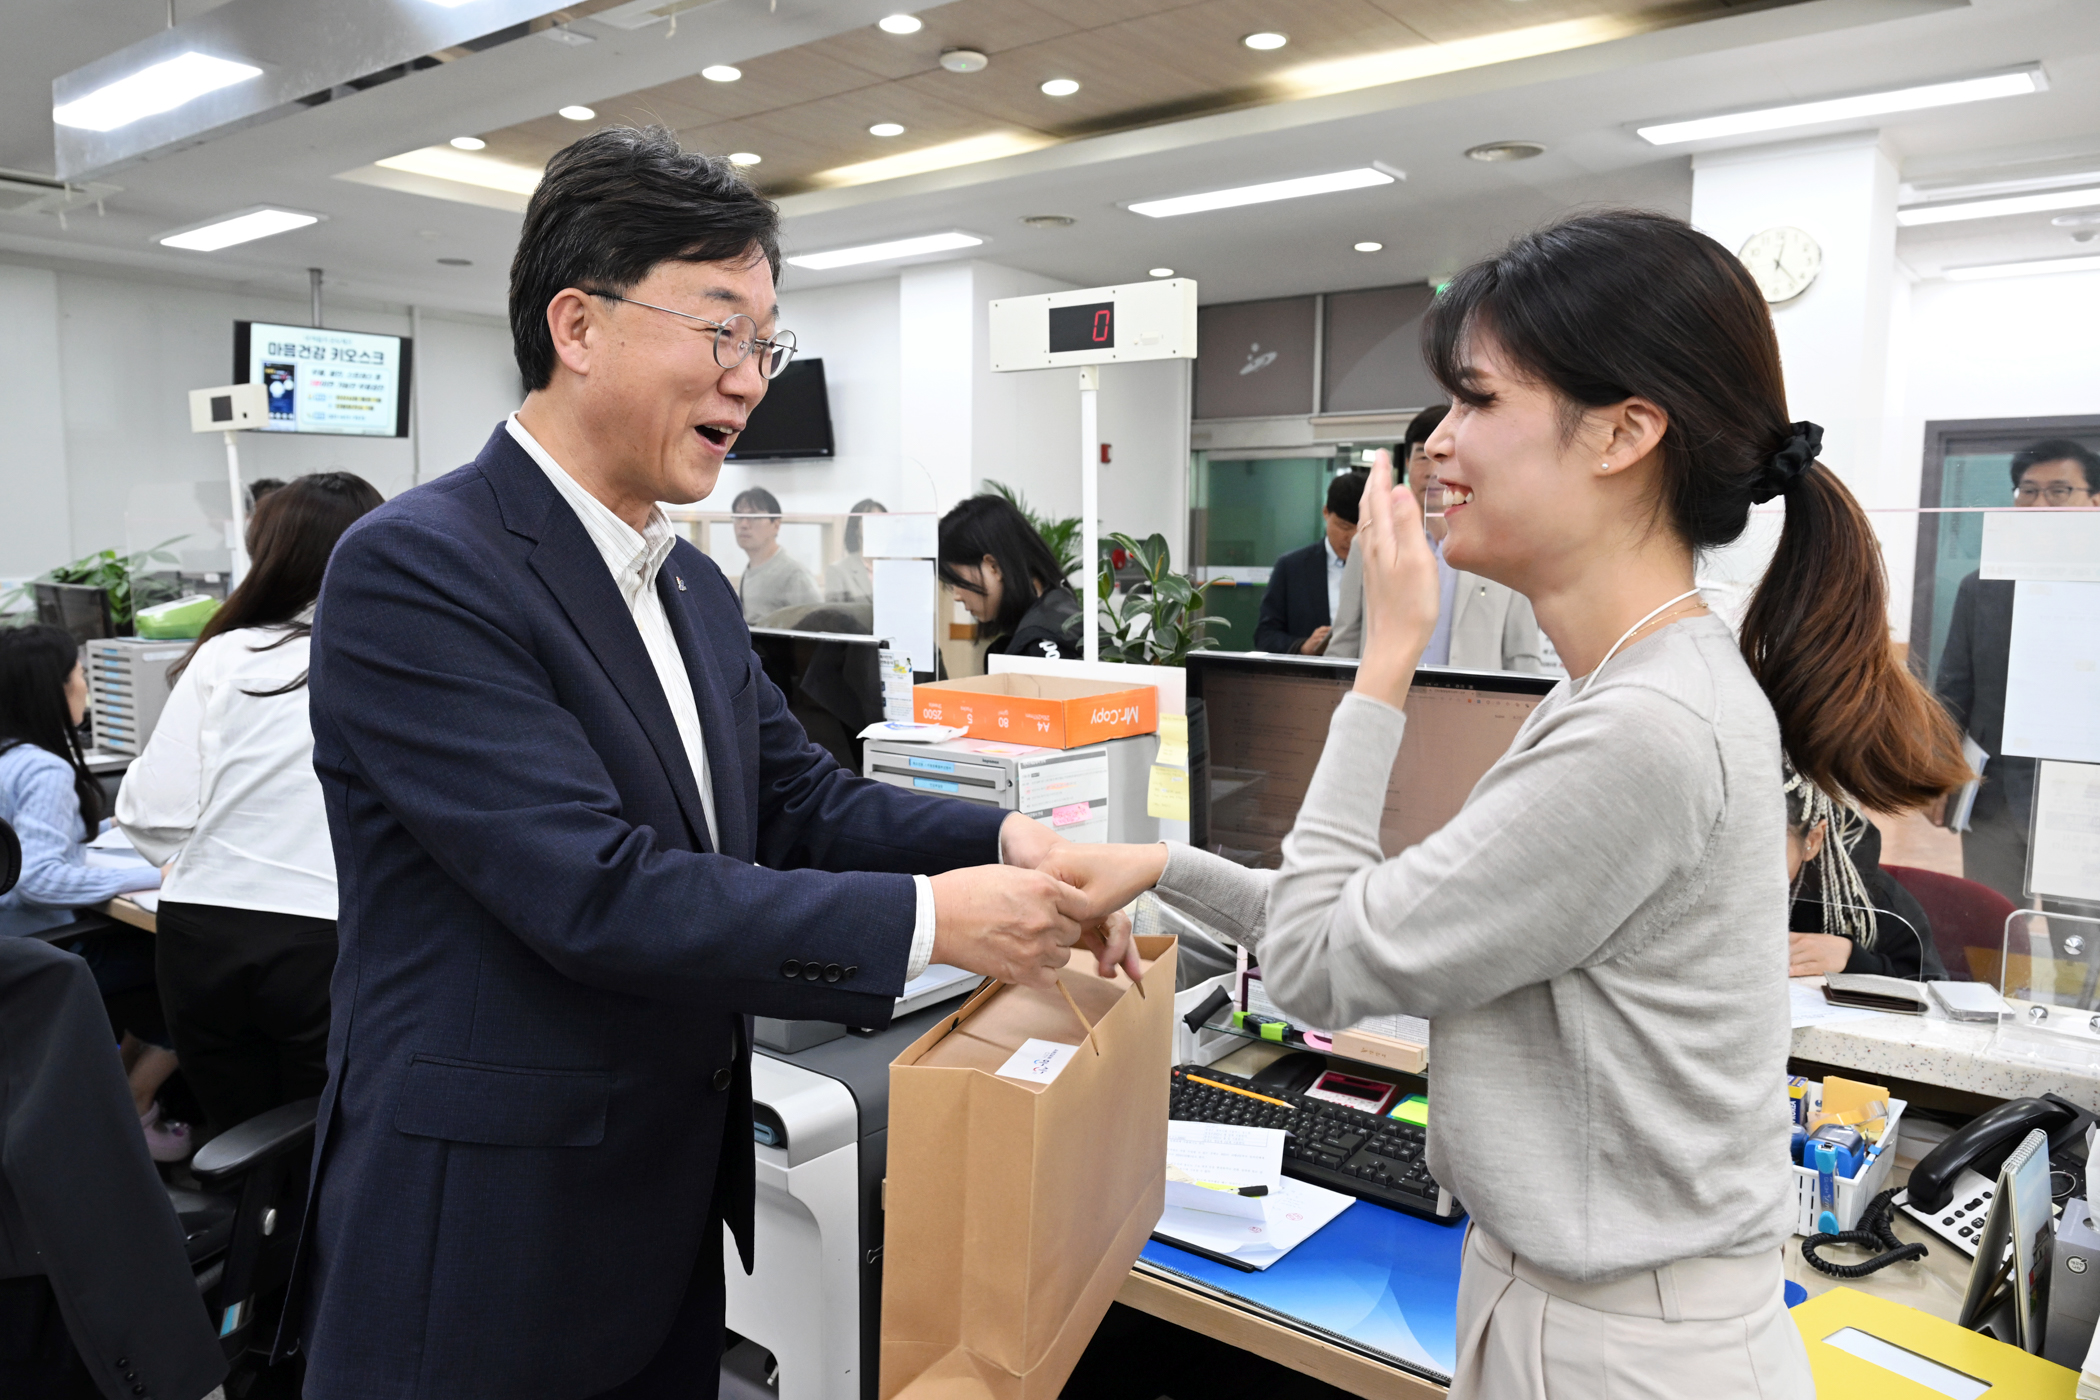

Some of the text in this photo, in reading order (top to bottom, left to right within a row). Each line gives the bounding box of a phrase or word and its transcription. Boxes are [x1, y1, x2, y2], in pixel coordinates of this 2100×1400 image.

[1092, 310, 1110, 342] 0
[268, 341, 385, 366] 마음건강 키오스크
[923, 708, 942, 720] 2500
[966, 713, 973, 724] 5
[1090, 705, 1139, 725] Mr.Copy
[998, 717, 1009, 729] 80
[1037, 721, 1050, 733] A4
